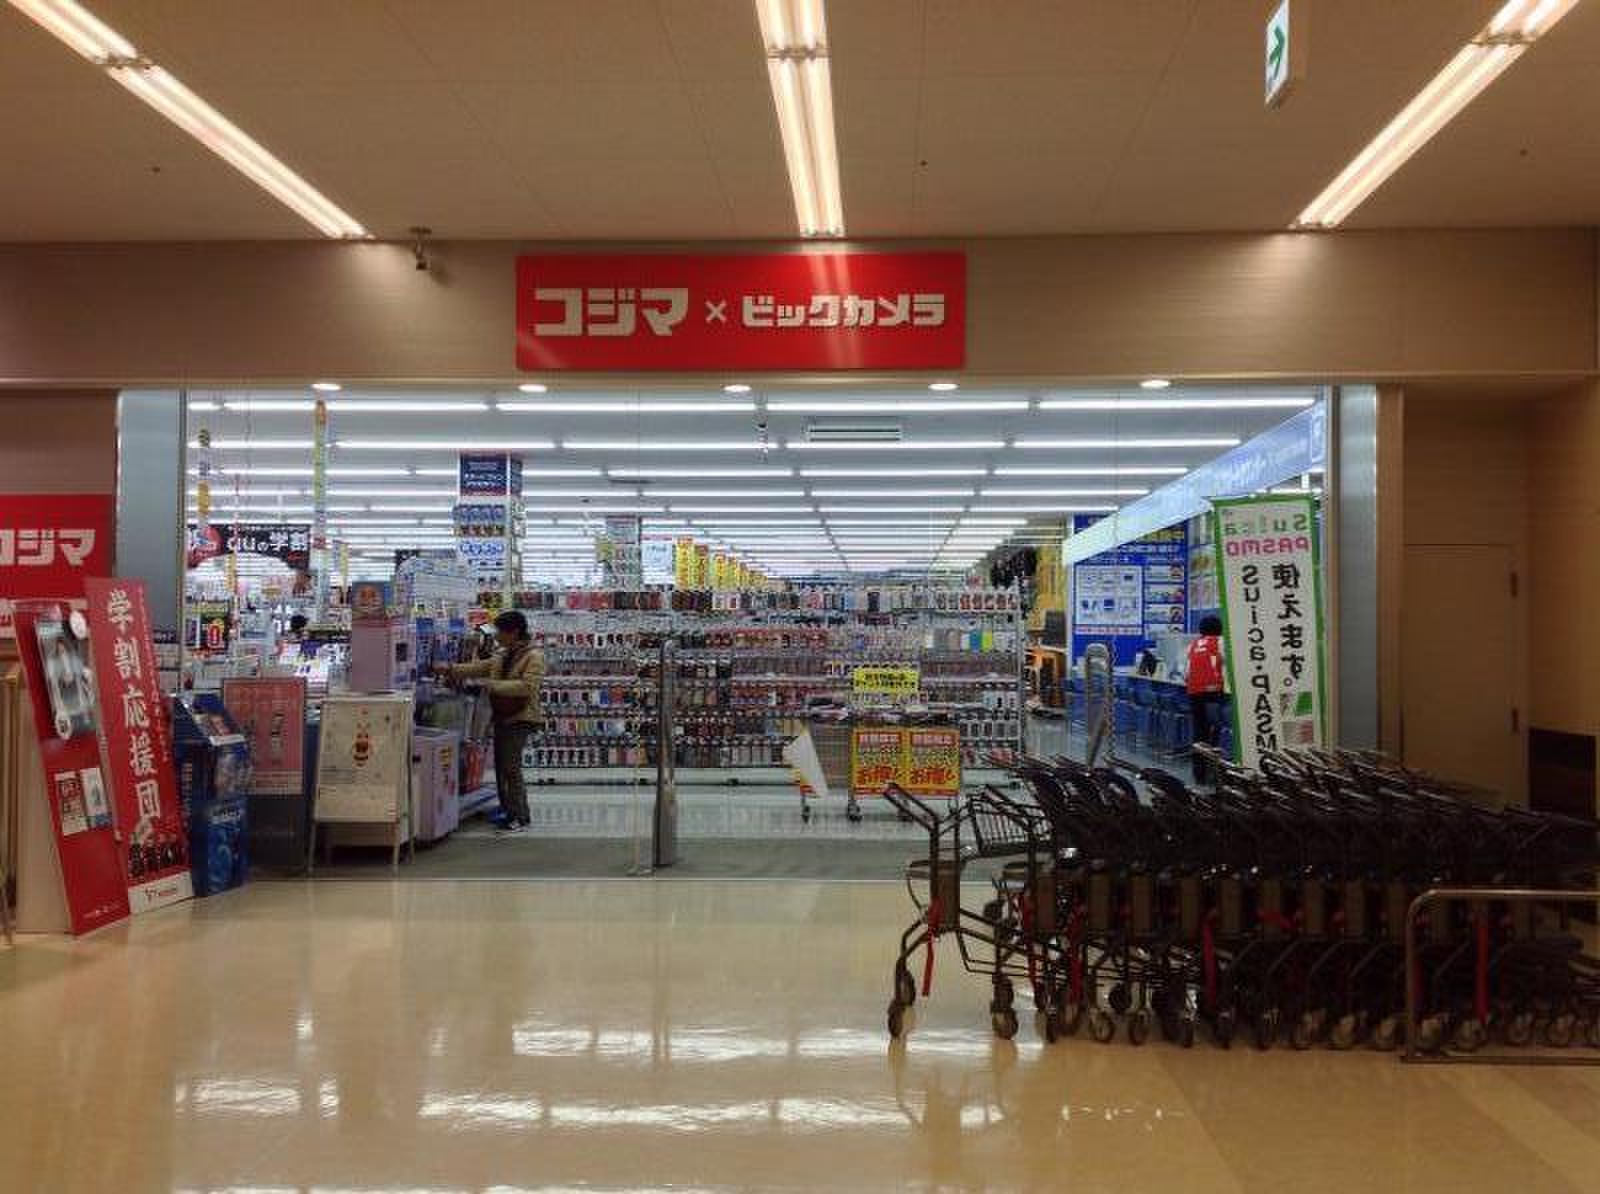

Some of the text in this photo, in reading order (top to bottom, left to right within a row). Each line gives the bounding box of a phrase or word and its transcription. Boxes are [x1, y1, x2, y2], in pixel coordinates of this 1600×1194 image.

[533, 287, 689, 337] コジマ
[742, 293, 945, 328] ビックカメラ
[107, 590, 161, 818] 学割応援団
